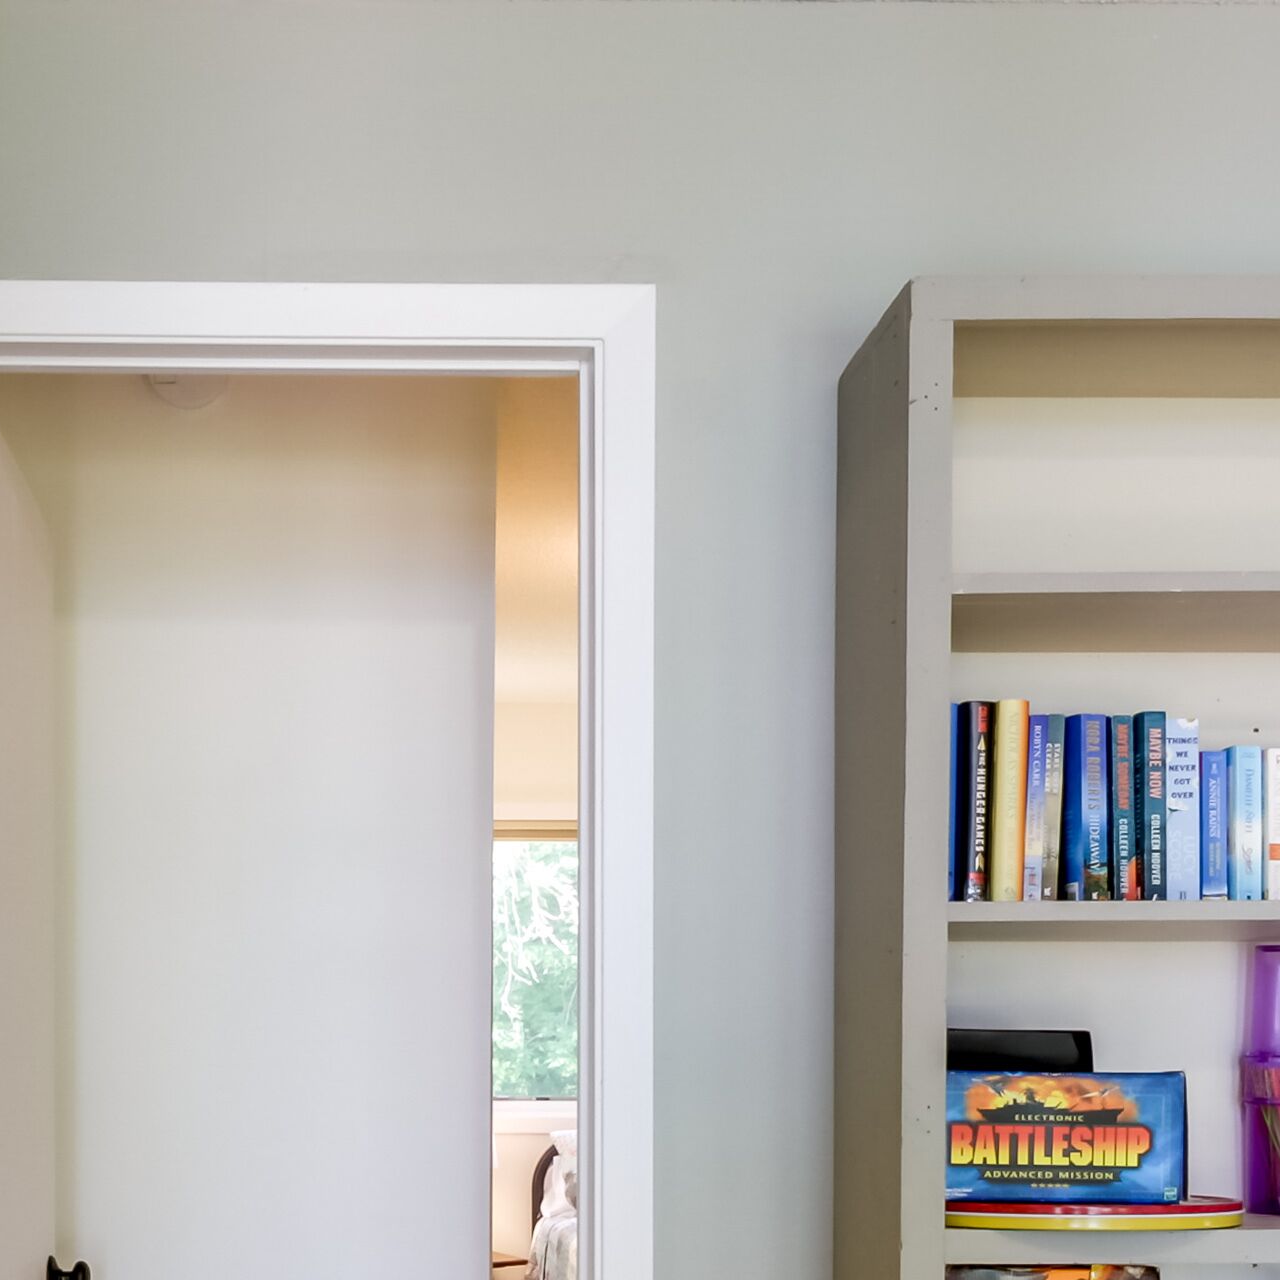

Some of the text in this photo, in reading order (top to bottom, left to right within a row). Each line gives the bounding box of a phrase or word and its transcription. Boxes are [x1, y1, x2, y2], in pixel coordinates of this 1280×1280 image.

[1032, 725, 1042, 787] ROBYN CARR
[1086, 720, 1100, 810] NORA ROBERTS
[1117, 724, 1129, 810] MAYBE SOMEDAY
[1149, 728, 1162, 799] MAYBE NOW
[976, 768, 985, 814] HUNGER
[1007, 776, 1018, 819] SPARKS
[1208, 778, 1217, 808] ANNIE
[975, 816, 985, 852] GAMES
[1088, 815, 1100, 870] HIDEAWAY
[1119, 818, 1128, 894] COLLEEN HOOVER
[1150, 814, 1160, 885] COLLEEN HOOVER
[1014, 1114, 1084, 1122] ELECTRONIC
[950, 1124, 1151, 1167] BATTLESHIP
[984, 1170, 1114, 1180] ADVANCED MISSION
